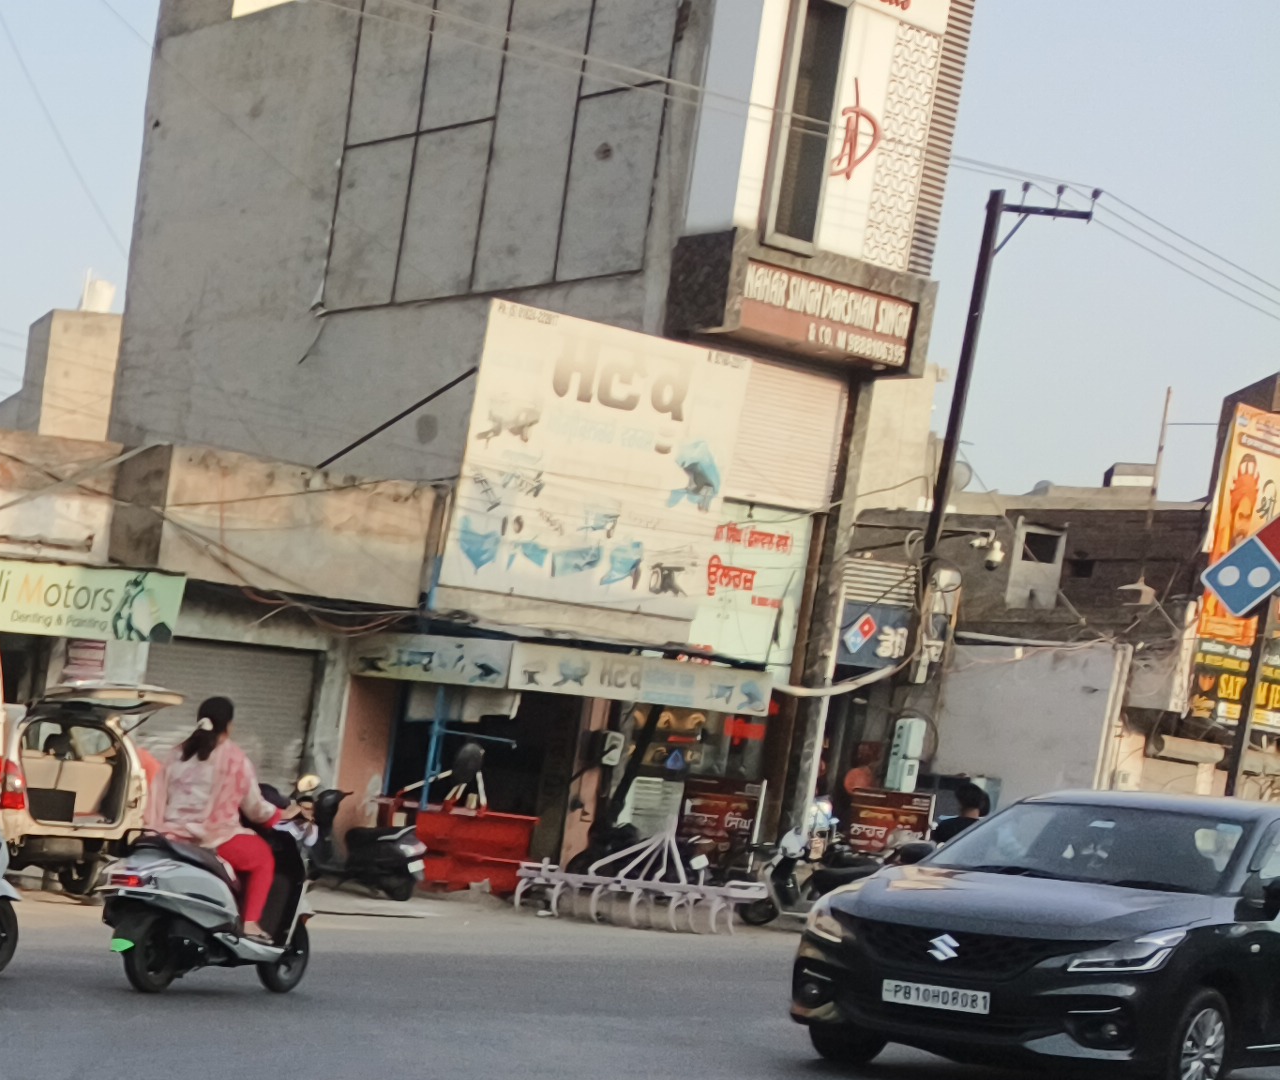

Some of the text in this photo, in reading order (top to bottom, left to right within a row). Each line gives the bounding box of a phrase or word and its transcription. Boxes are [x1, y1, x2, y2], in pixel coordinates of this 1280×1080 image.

[786, 275, 825, 318] SINGH
[16, 573, 116, 613] Motors
[10, 609, 53, 629] Denting
[65, 614, 109, 633] Painting
